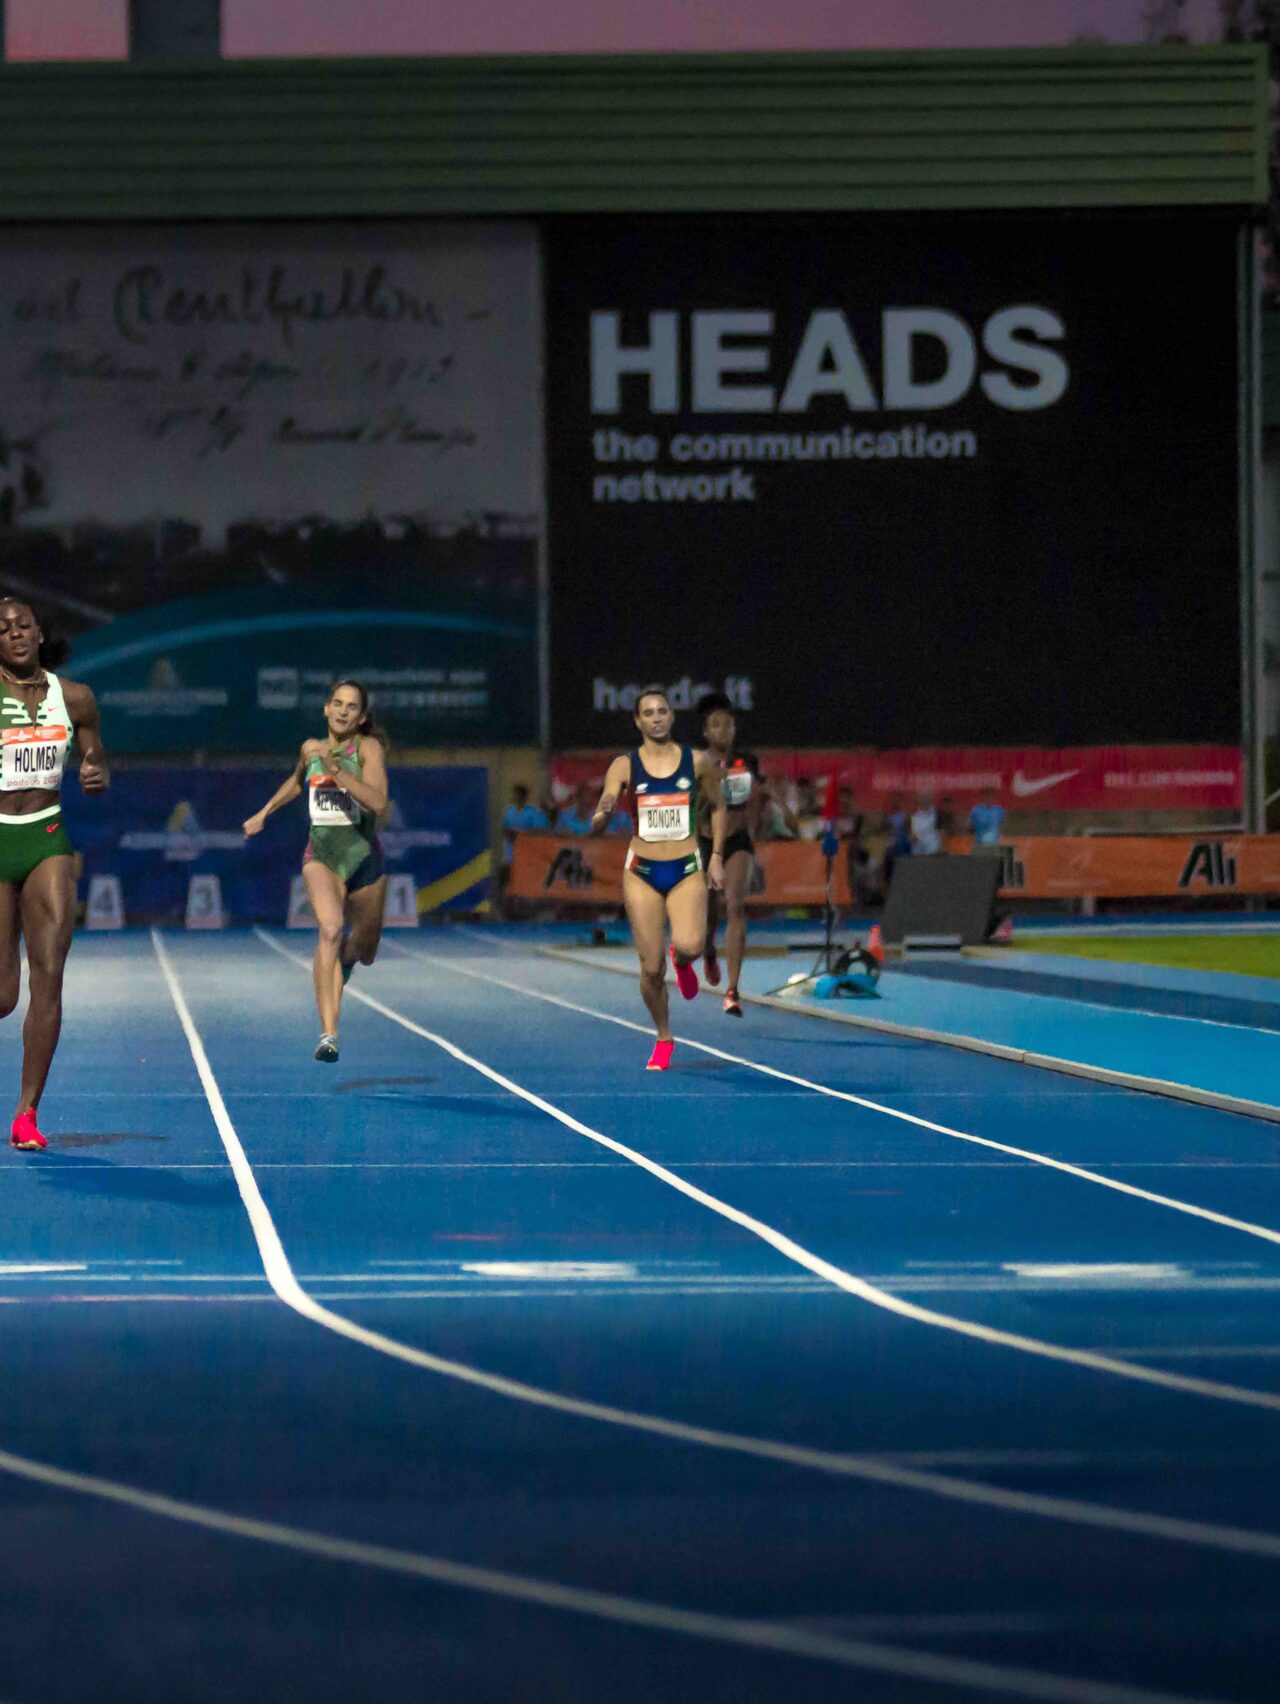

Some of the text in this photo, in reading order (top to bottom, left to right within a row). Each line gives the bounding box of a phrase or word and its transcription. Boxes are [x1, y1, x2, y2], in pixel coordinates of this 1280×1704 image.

[590, 305, 1069, 413] HEADS
[593, 425, 977, 461] the communication
[593, 467, 755, 502] network
[14, 745, 58, 773] HOLMES
[647, 809, 681, 829] BONORA
[93, 887, 114, 913] 4
